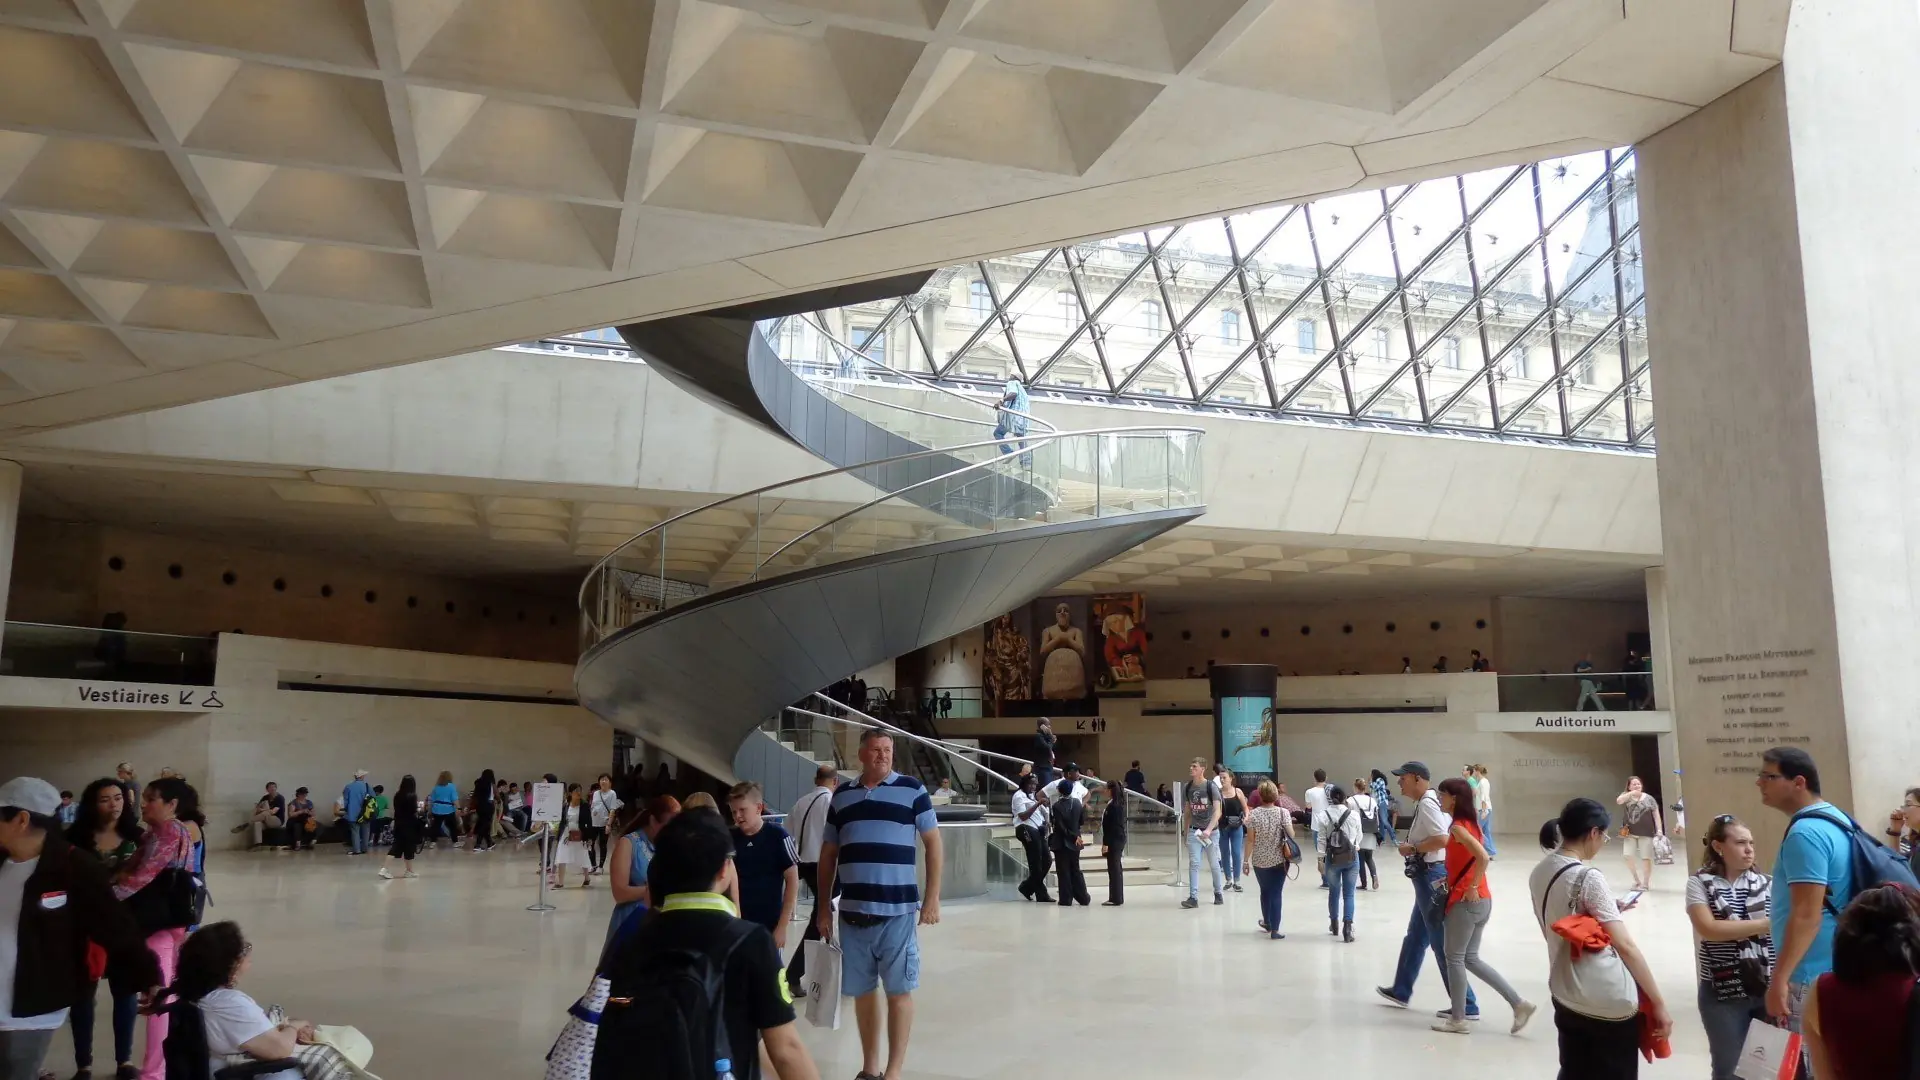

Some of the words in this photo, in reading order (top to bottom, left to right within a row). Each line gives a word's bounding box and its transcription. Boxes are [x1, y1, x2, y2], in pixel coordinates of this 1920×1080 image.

[1737, 673, 1747, 681] DE
[1748, 672, 1759, 680] LA
[78, 686, 170, 705] Vestiaires
[1535, 716, 1616, 727] Auditorium
